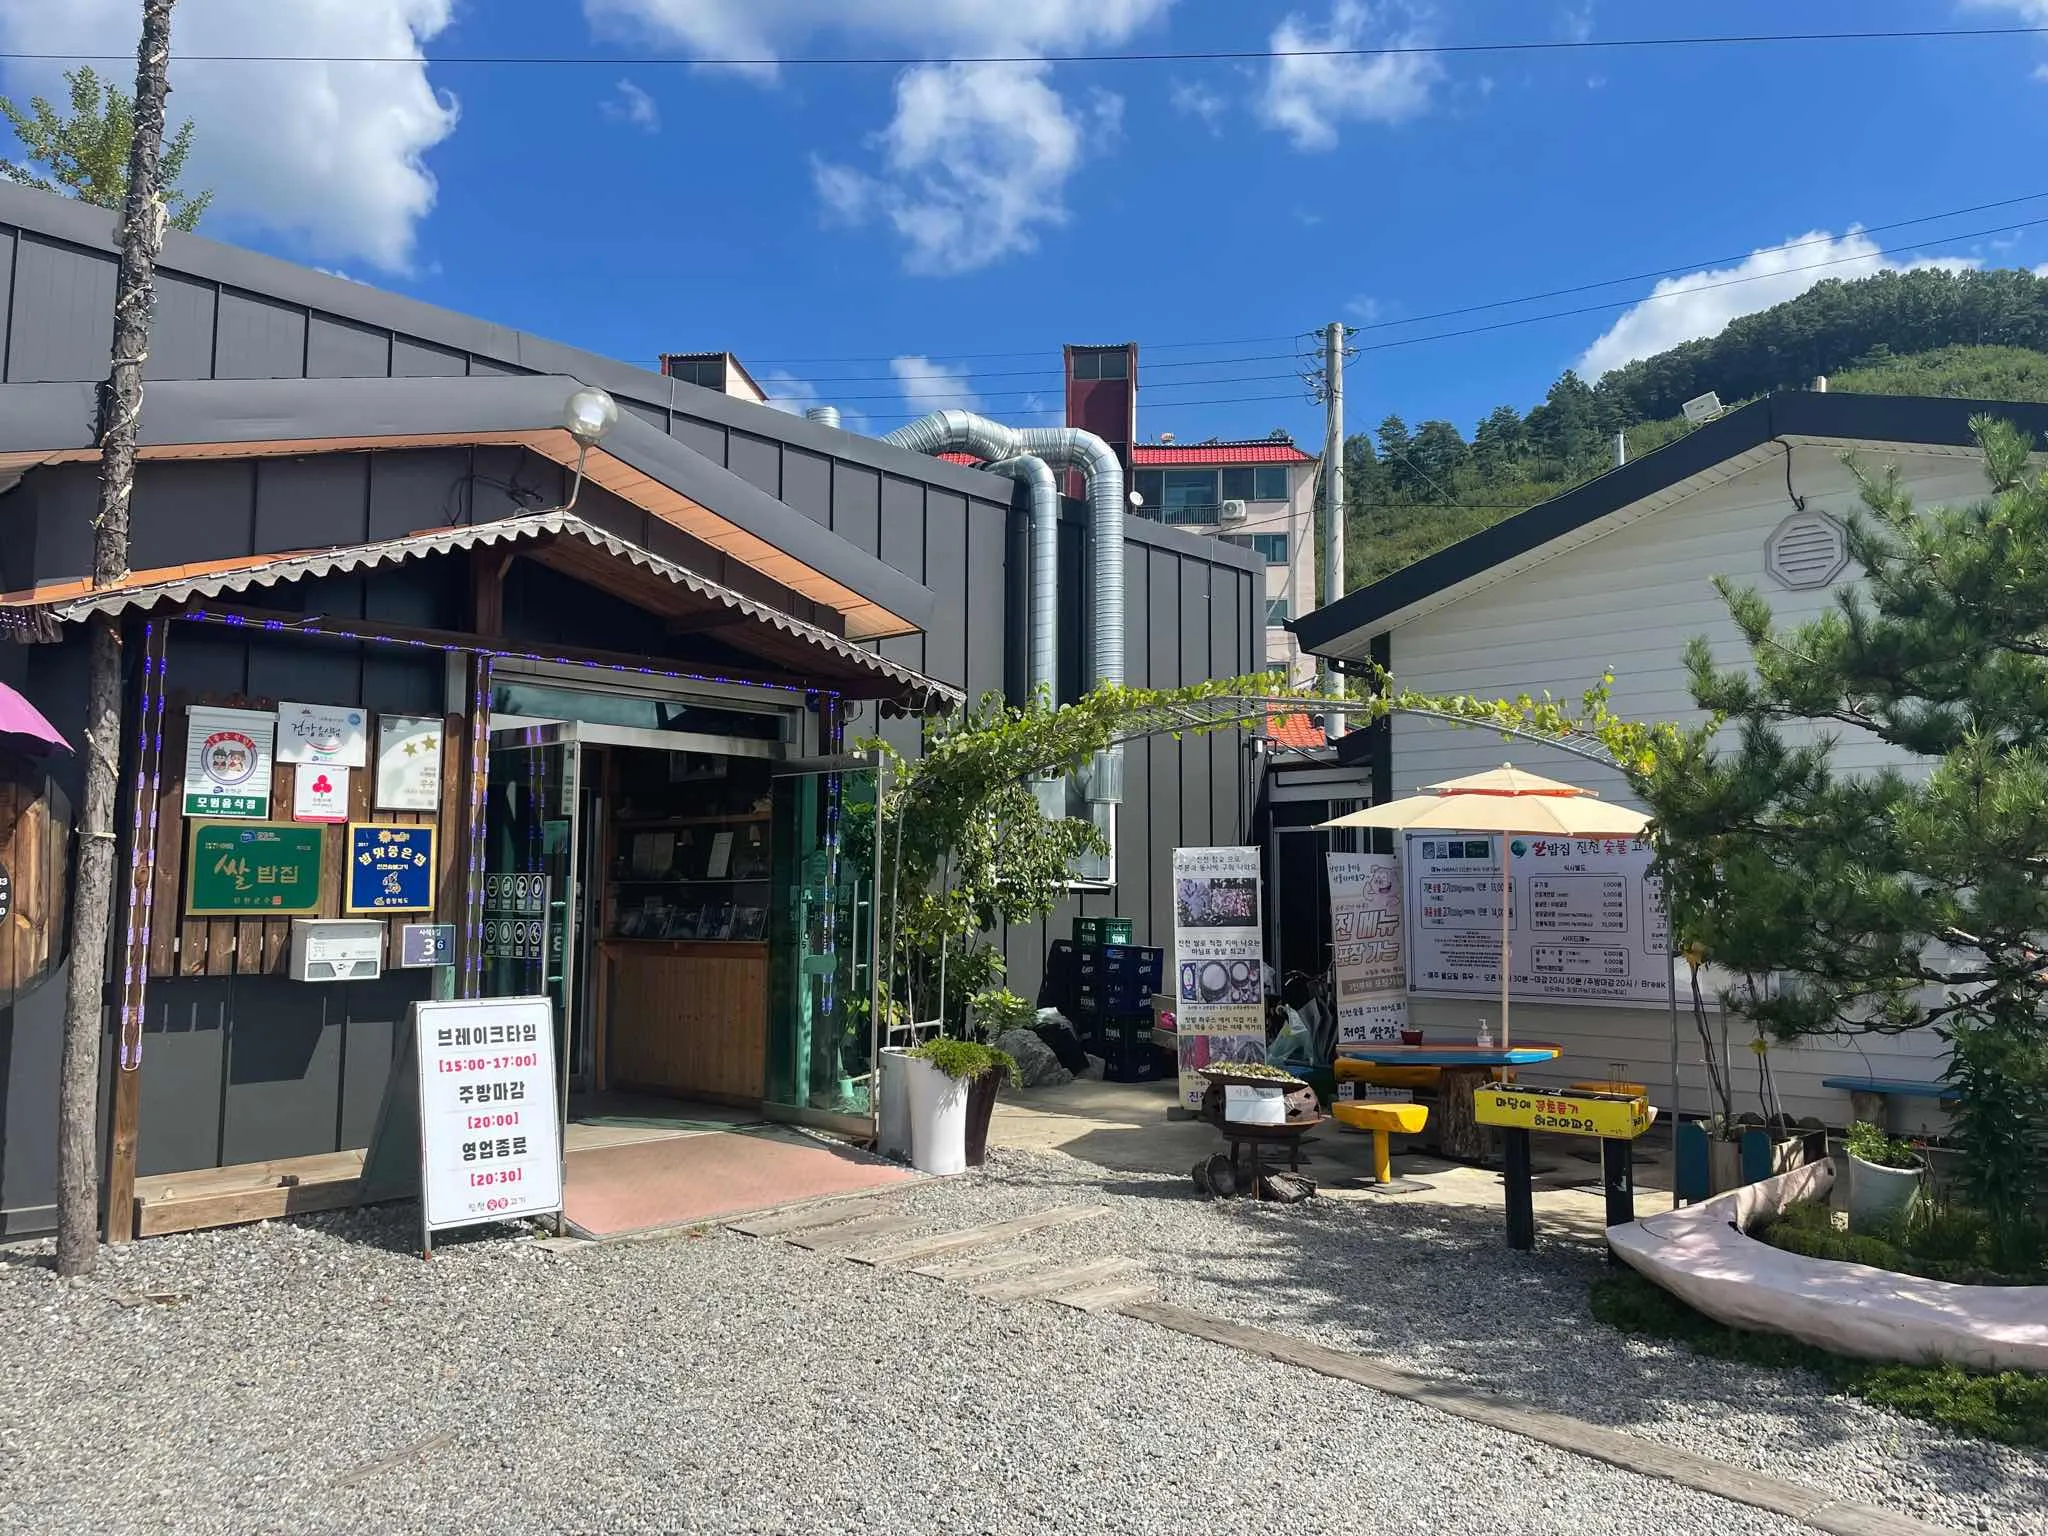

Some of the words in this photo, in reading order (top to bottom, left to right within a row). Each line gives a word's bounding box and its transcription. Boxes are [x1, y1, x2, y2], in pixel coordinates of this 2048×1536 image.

[197, 797, 256, 809] 모범음식점
[1532, 840, 1570, 856] 쌀밥집
[1576, 840, 1600, 855] 진천
[1603, 840, 1626, 855] 숯불
[1335, 913, 1355, 941] 전
[1357, 909, 1400, 939] 메뉴
[1335, 944, 1366, 967] 포장
[1366, 941, 1401, 965] 가능
[438, 1024, 536, 1047] 브레이크타임
[1343, 1026, 1366, 1039] 저염
[1370, 1026, 1397, 1039] 쌈장
[438, 1053, 537, 1073] [15:00-17:00]
[459, 1081, 525, 1104] 주방마감
[1495, 1097, 1531, 1110] 마당에
[467, 1111, 519, 1129] [20:00]
[462, 1136, 527, 1161] 영업종료
[470, 1167, 522, 1187] [20:30]
